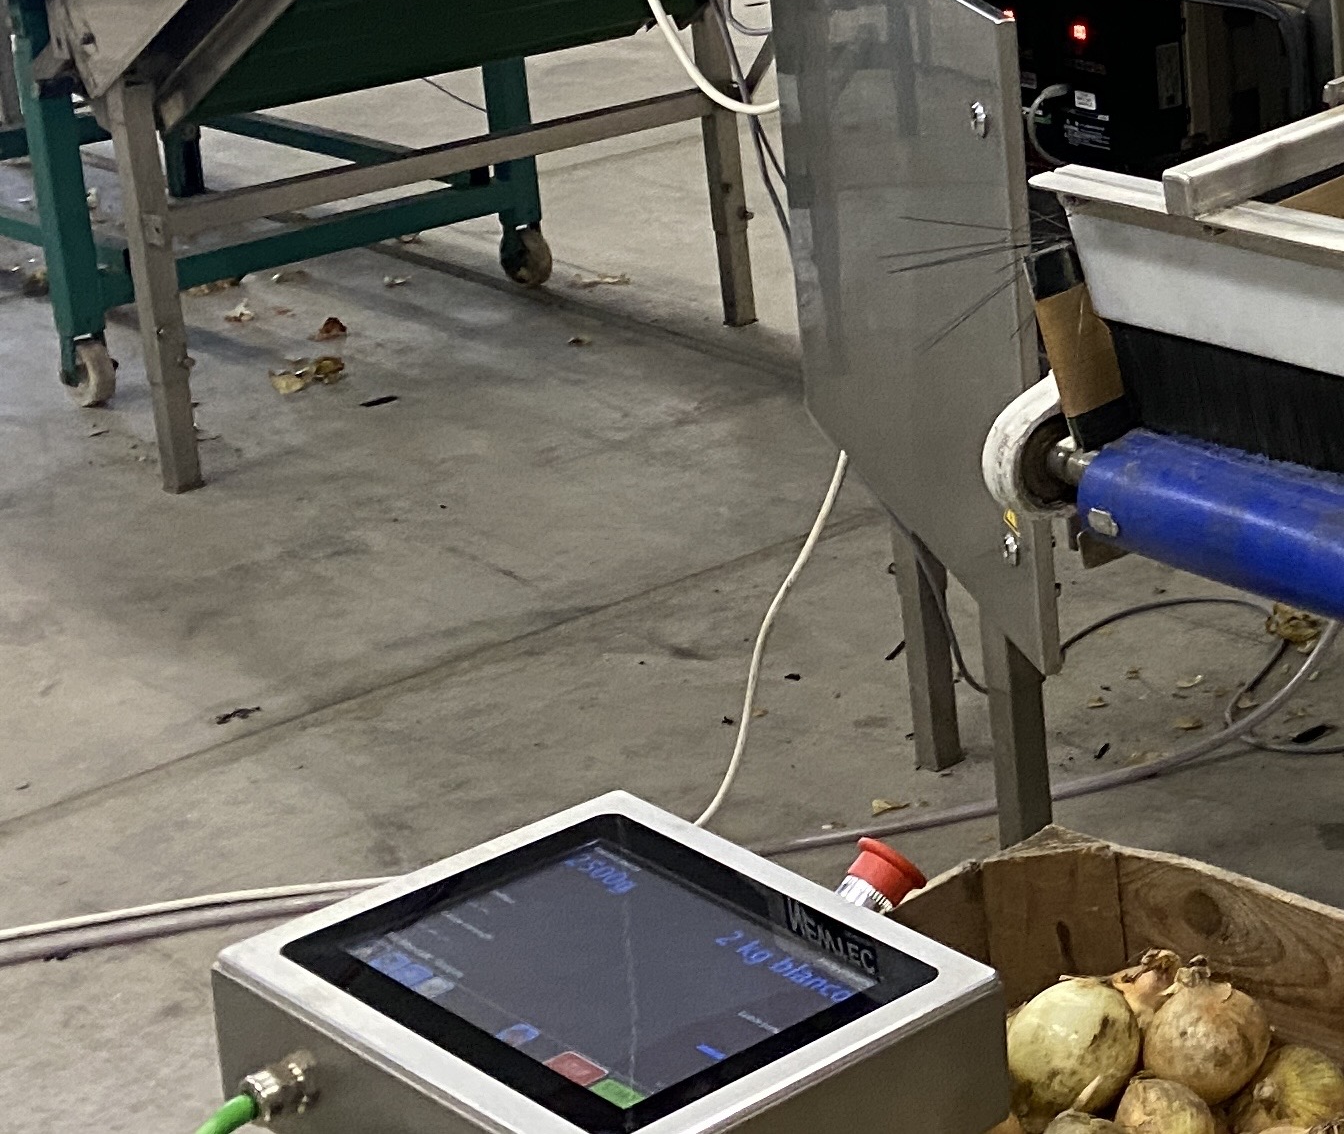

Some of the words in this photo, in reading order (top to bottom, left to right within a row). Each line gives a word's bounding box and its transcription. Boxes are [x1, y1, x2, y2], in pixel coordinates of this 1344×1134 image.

[715, 929, 744, 947] 2
[736, 939, 774, 966] kg
[769, 955, 854, 1004] blanco
